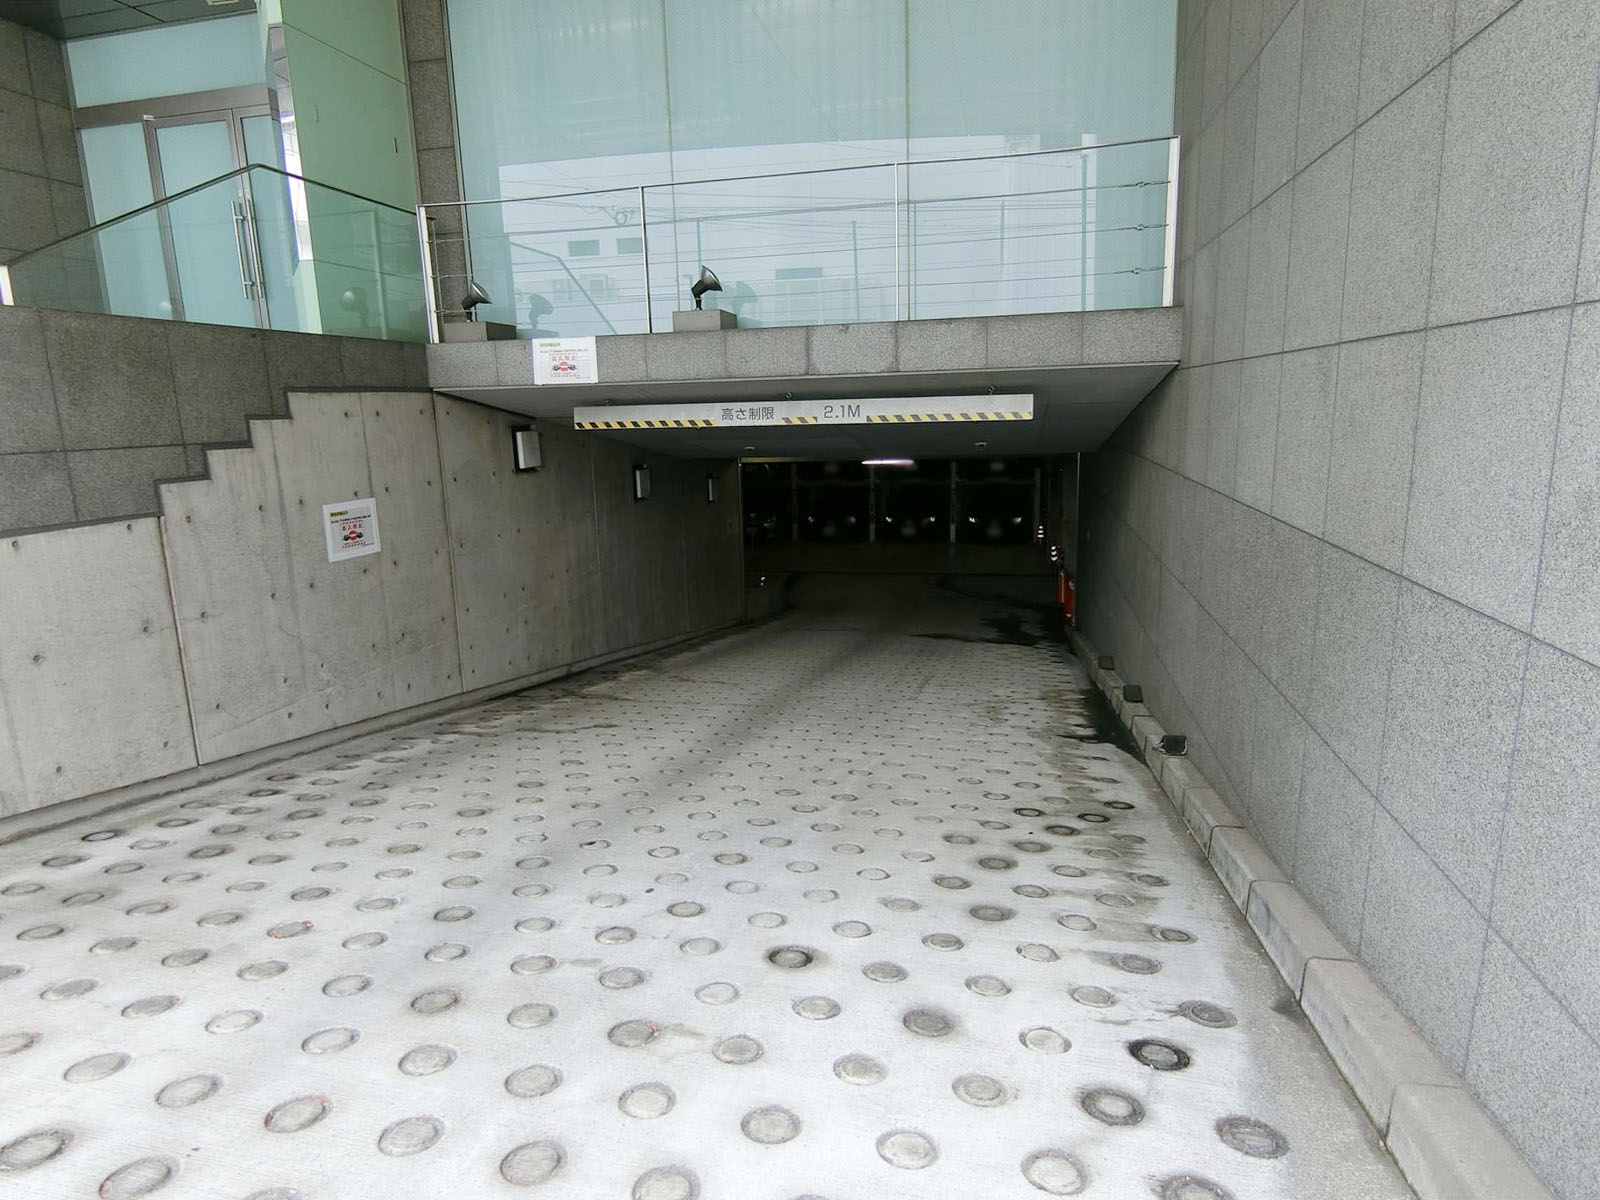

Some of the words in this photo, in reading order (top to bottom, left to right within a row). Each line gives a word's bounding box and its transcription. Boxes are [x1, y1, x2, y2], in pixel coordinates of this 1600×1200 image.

[721, 406, 775, 421] 高さ制限
[823, 404, 861, 419] 2.1M
